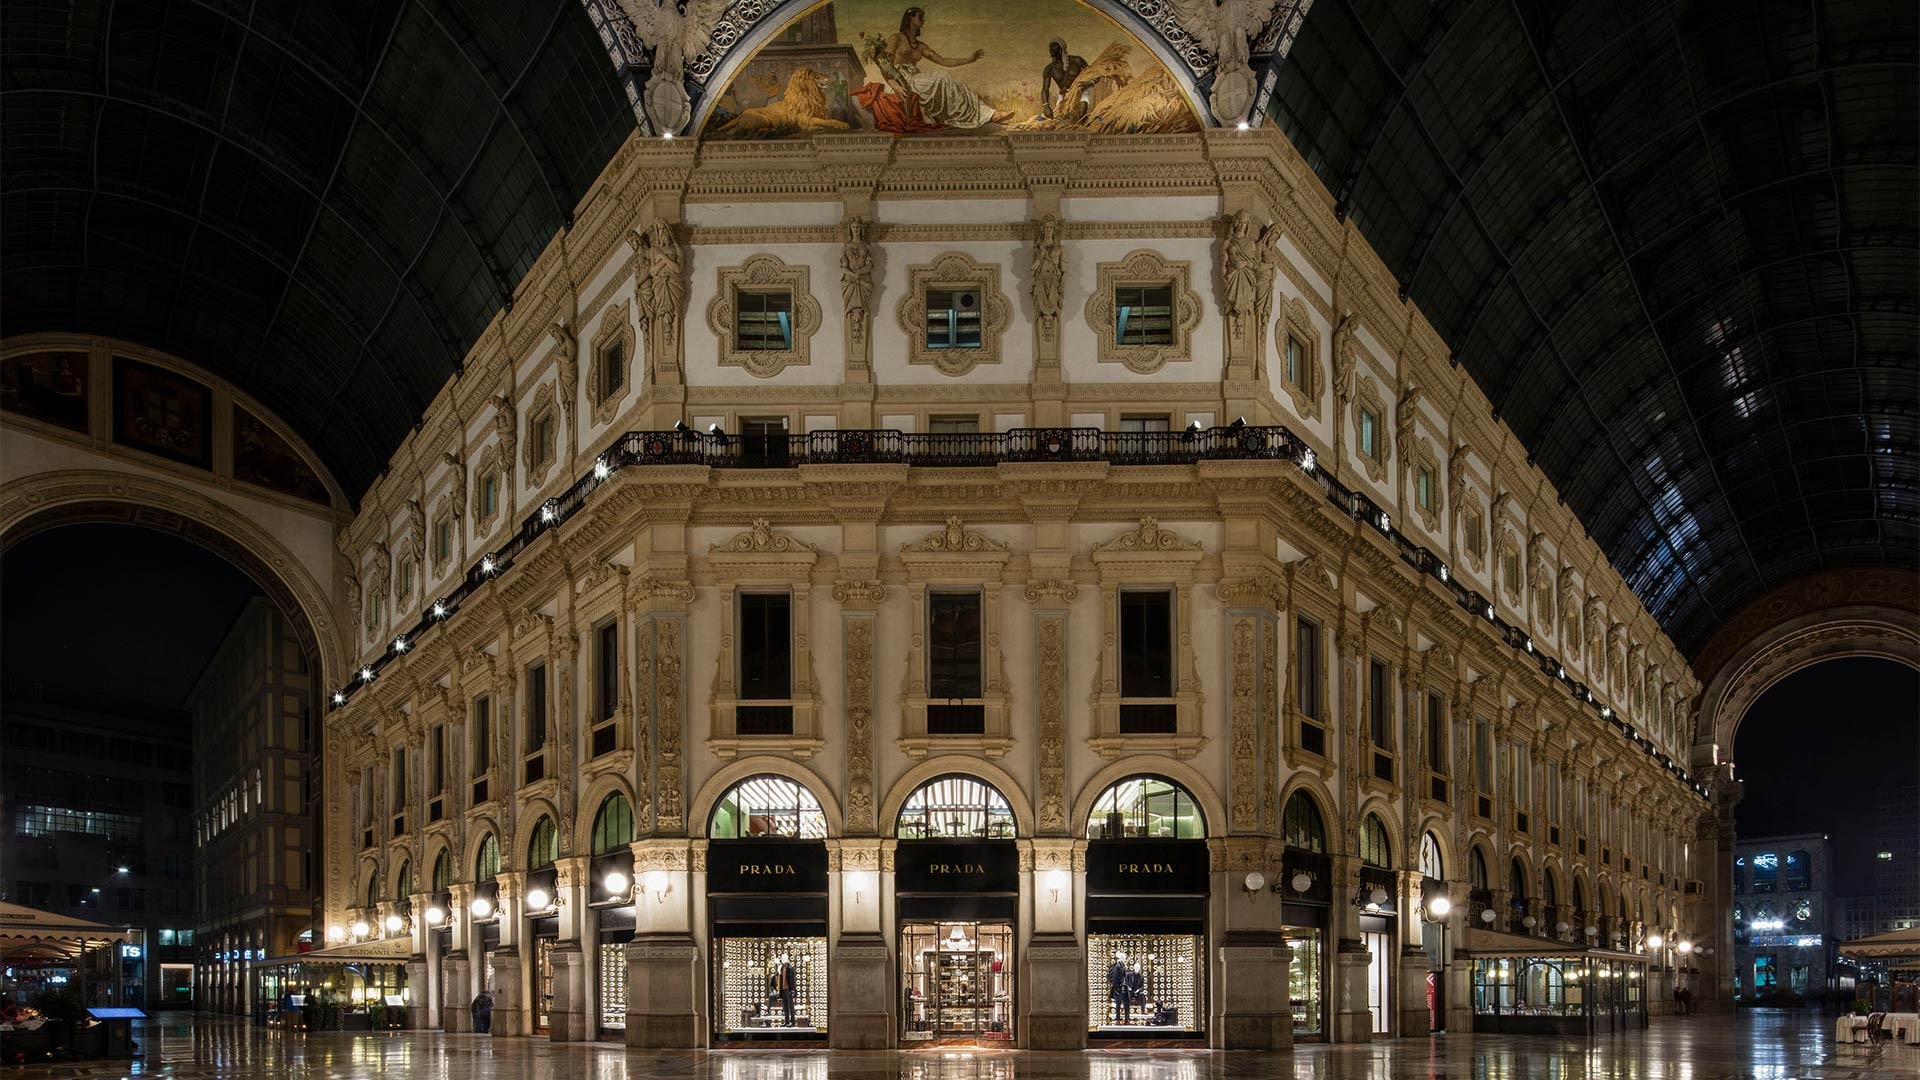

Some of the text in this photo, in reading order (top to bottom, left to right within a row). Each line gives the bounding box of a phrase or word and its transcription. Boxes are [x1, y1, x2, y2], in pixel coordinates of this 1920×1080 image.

[740, 864, 796, 875] PRADA
[929, 863, 985, 874] PRADA
[1119, 863, 1174, 873] PRADA
